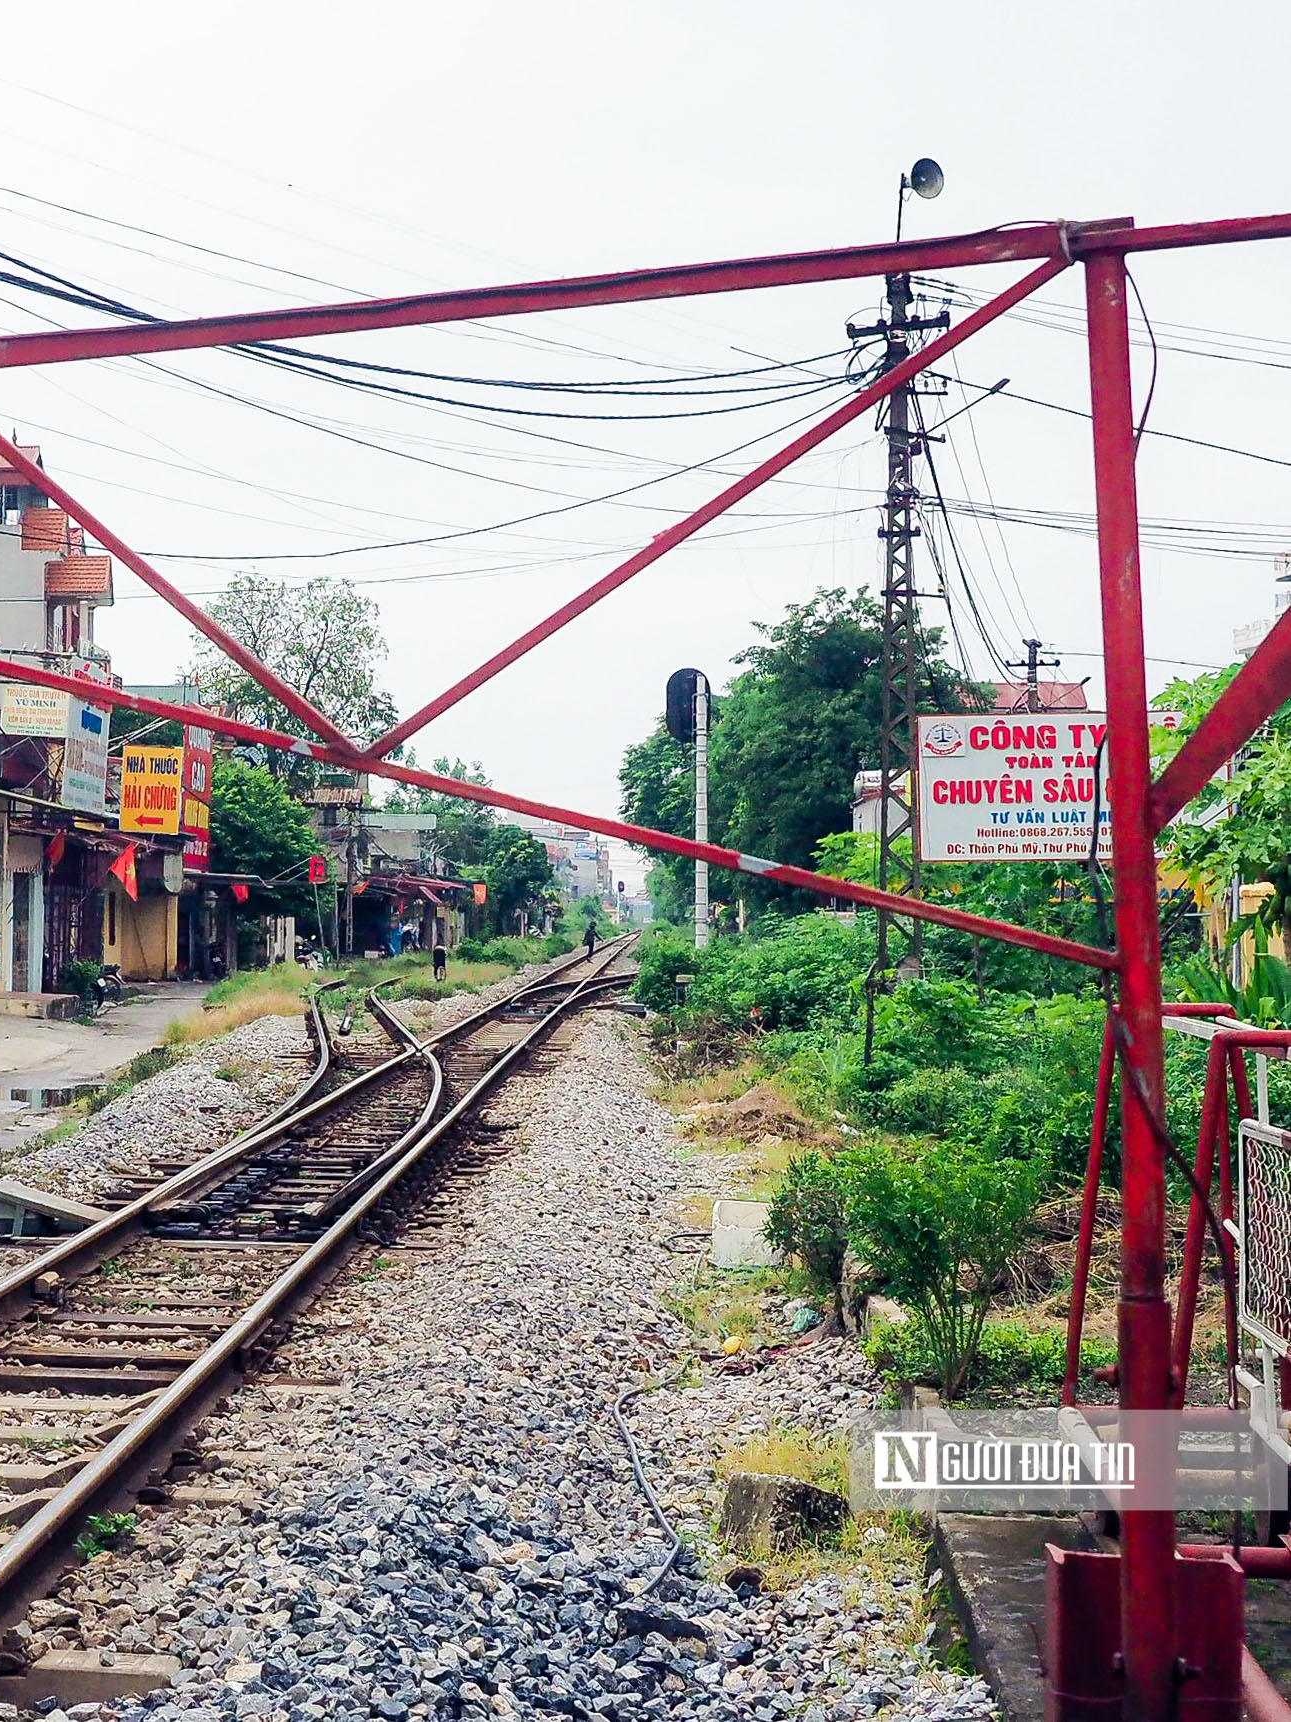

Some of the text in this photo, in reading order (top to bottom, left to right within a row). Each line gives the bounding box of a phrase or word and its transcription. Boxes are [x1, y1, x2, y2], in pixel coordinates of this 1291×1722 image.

[31, 699, 56, 708] MINH
[970, 720, 1056, 750] CÔNG
[126, 753, 146, 774] NHÀ
[149, 753, 179, 776] THUỐC
[1005, 753, 1053, 769] TOÀN
[123, 777, 142, 809] HẢI
[933, 773, 1033, 804] CHUYÊN
[1043, 772, 1094, 803] SÂU
[991, 811, 1011, 824] TƯ
[1016, 808, 1045, 824] VẤN
[1051, 808, 1087, 825] LUẬT
